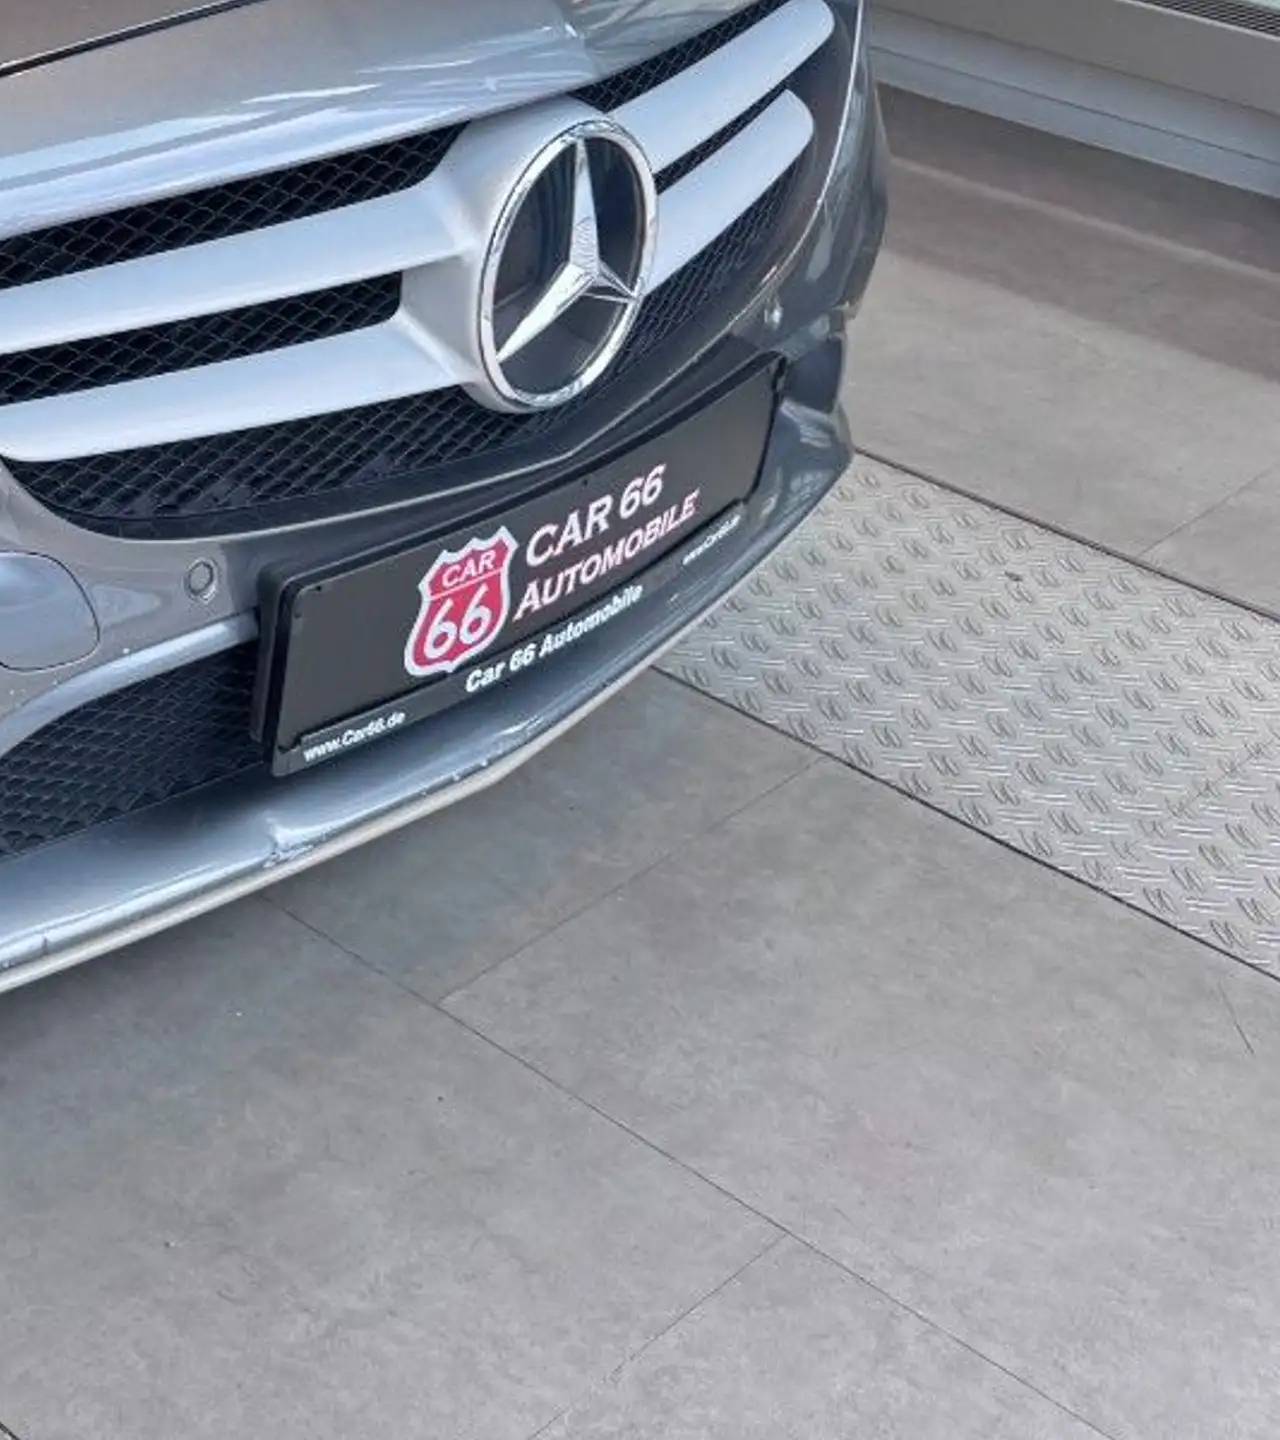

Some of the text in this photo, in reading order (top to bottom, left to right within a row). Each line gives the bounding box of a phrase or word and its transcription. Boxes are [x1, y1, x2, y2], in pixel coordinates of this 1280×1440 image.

[512, 488, 701, 622] AUTOMOBILE
[525, 463, 667, 567] CAR 66
[441, 549, 495, 589] CAR
[423, 584, 493, 659] 66
[465, 584, 644, 693] Car 66 Automobile
